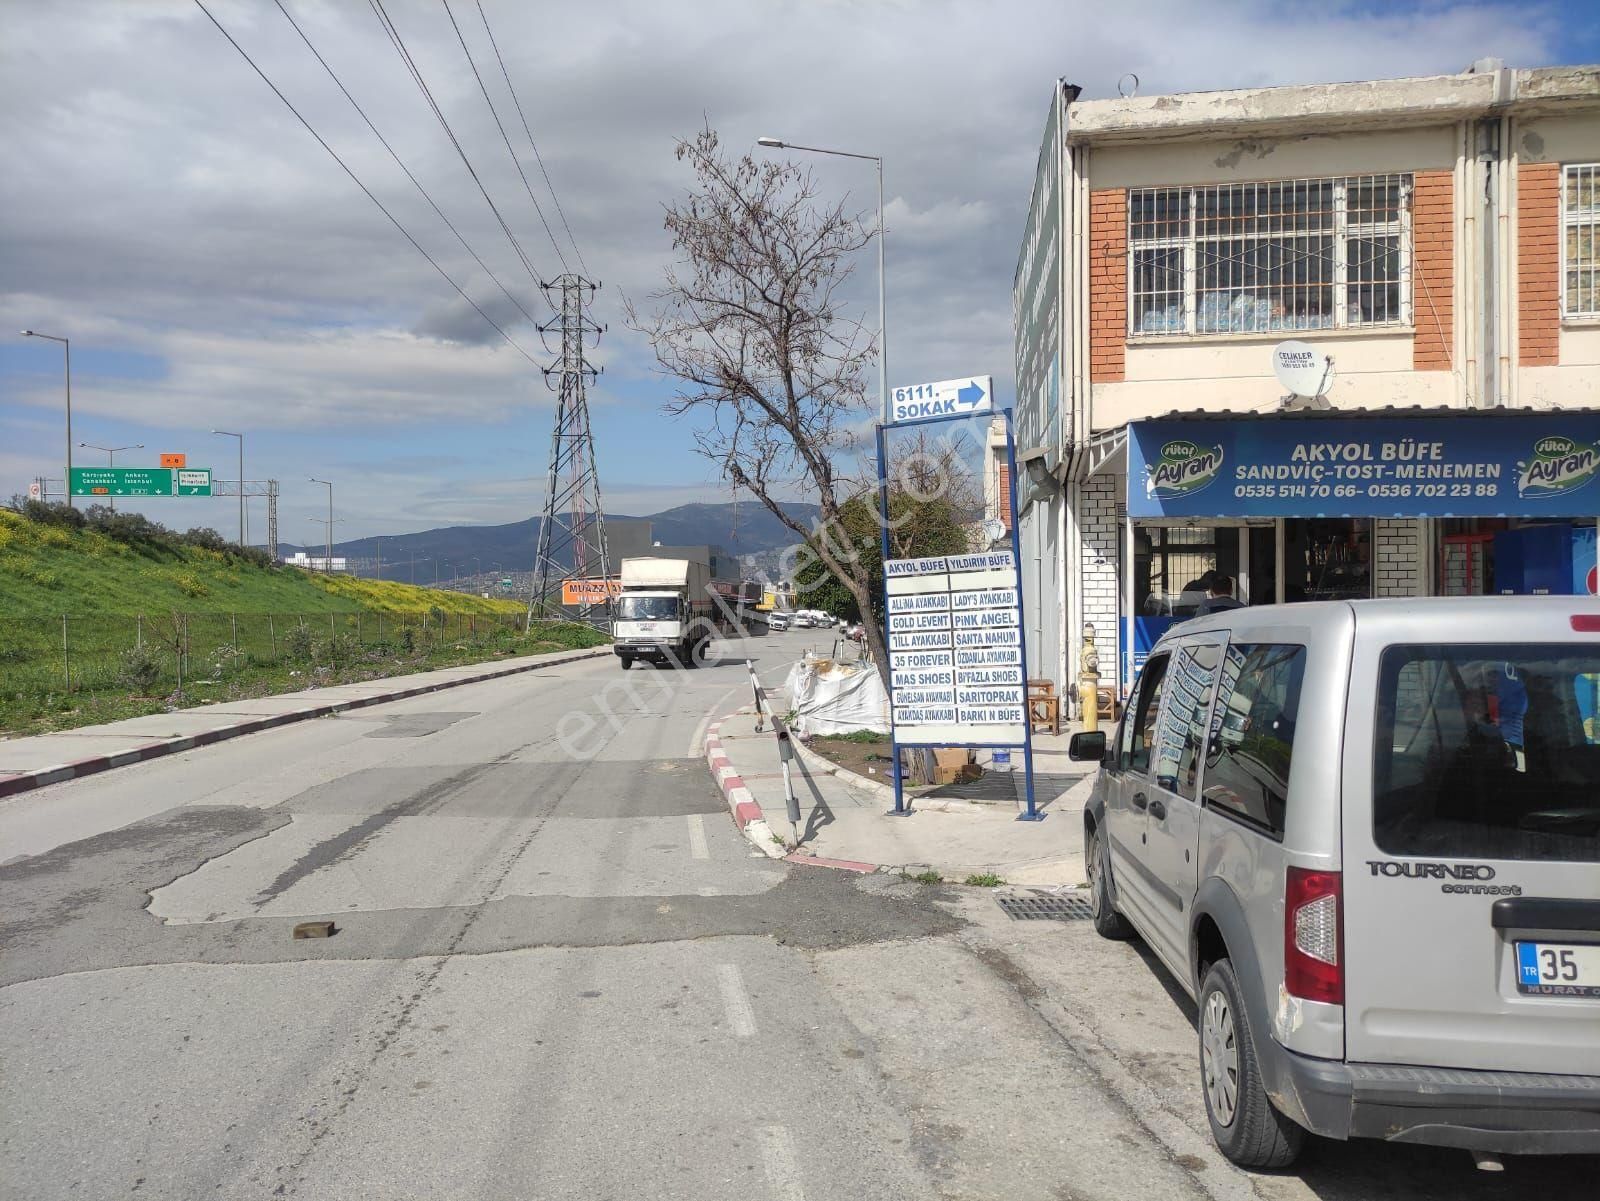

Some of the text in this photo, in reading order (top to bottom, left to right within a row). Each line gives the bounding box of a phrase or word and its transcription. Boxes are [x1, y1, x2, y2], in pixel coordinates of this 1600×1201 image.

[896, 385, 940, 402] 6111.
[897, 398, 956, 419] SOKAK
[1291, 438, 1443, 462] AKYOL BÜFE
[1154, 453, 1214, 485] Ayran
[1527, 450, 1592, 484] Ayran
[1234, 484, 1276, 498] 0535
[1279, 484, 1306, 498] 514
[1310, 484, 1331, 498] 70
[1368, 484, 1411, 498] 0536
[1415, 484, 1447, 498] 702
[1450, 484, 1471, 498] 23
[1475, 484, 1497, 498] 88
[889, 560, 944, 574] AKYOL BÜFE
[950, 554, 1010, 569] YILDIRIM BÜFE
[915, 596, 948, 609] AYAKKABI
[954, 592, 1014, 606] LADY'S AYAKKABI
[893, 615, 948, 628] GOLD LEVENT
[981, 612, 1014, 625] ANGEL
[911, 634, 950, 646] AYAKKABI
[956, 631, 1016, 645] SANTA NAHUM
[895, 654, 950, 667] 35 FOREVER
[987, 651, 1017, 663] AYAKKABI
[895, 672, 951, 685] MAS SHOES
[992, 670, 1018, 682] SHOES
[959, 690, 1019, 703] SARITOPRAK
[924, 709, 954, 721] AYAKKABI
[998, 708, 1021, 720] BÜFE
[1366, 861, 1496, 881] TOURNEO
[1442, 883, 1522, 896] connect
[1523, 949, 1578, 981] TR 35
[1528, 985, 1587, 995] MURAT
